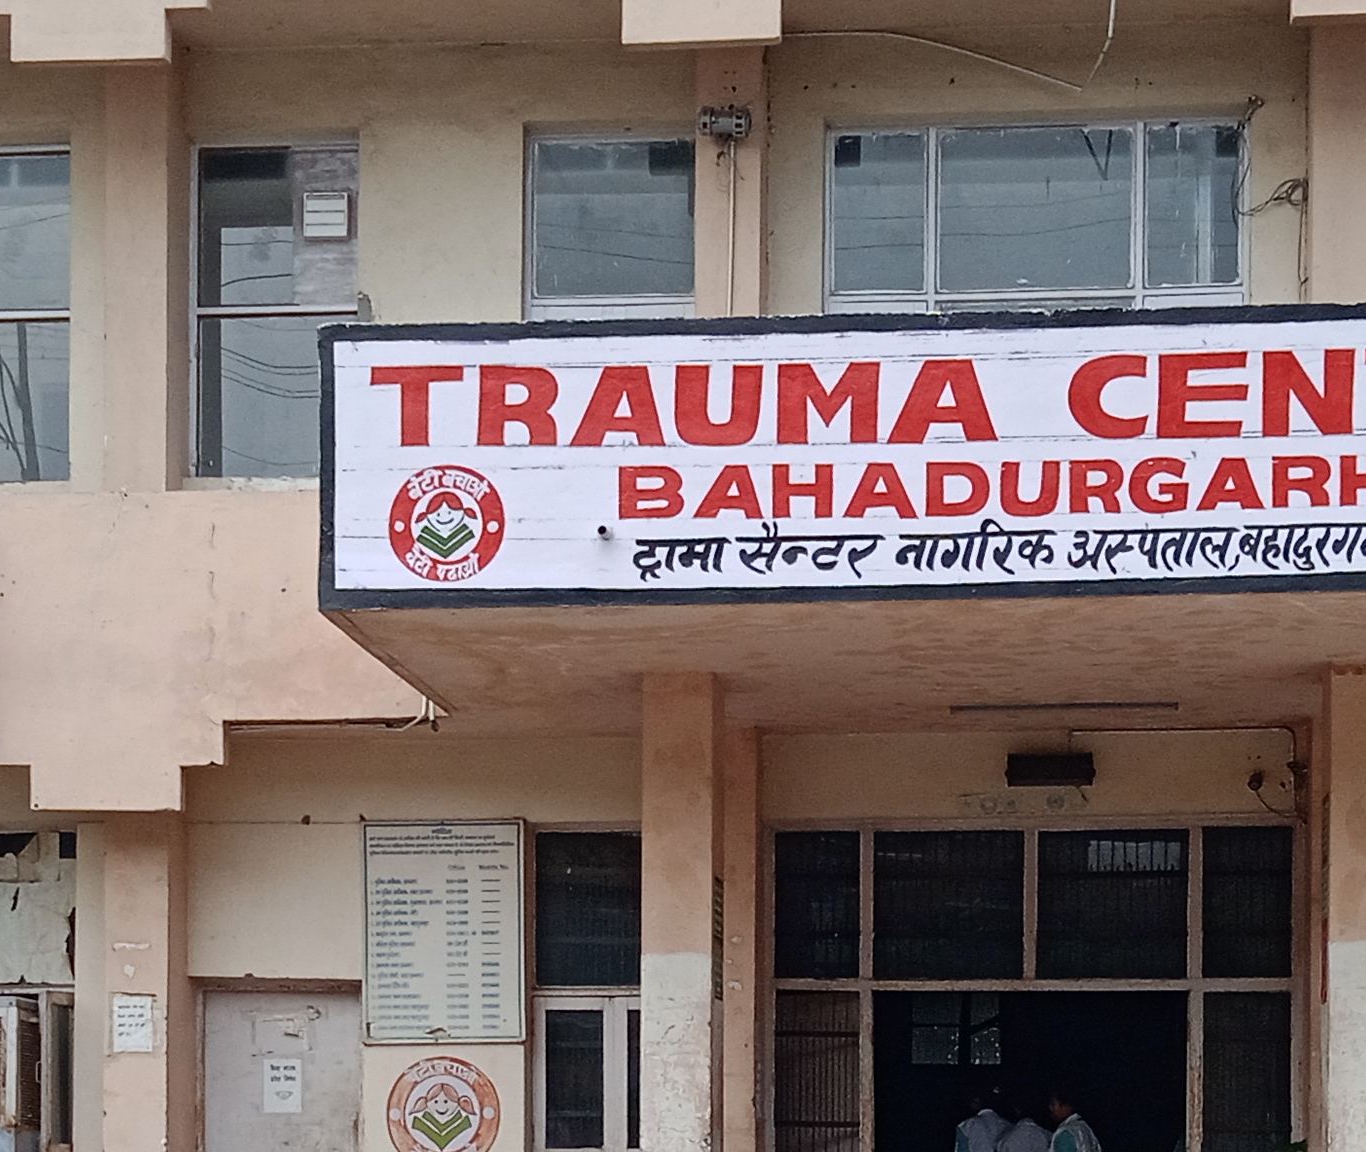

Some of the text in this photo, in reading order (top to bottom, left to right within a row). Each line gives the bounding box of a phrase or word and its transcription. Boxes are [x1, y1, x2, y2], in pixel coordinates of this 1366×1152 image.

[370, 358, 998, 447] TRAUMA
[736, 523, 885, 579] सैन्टर
[895, 519, 1054, 576] नागरिक
